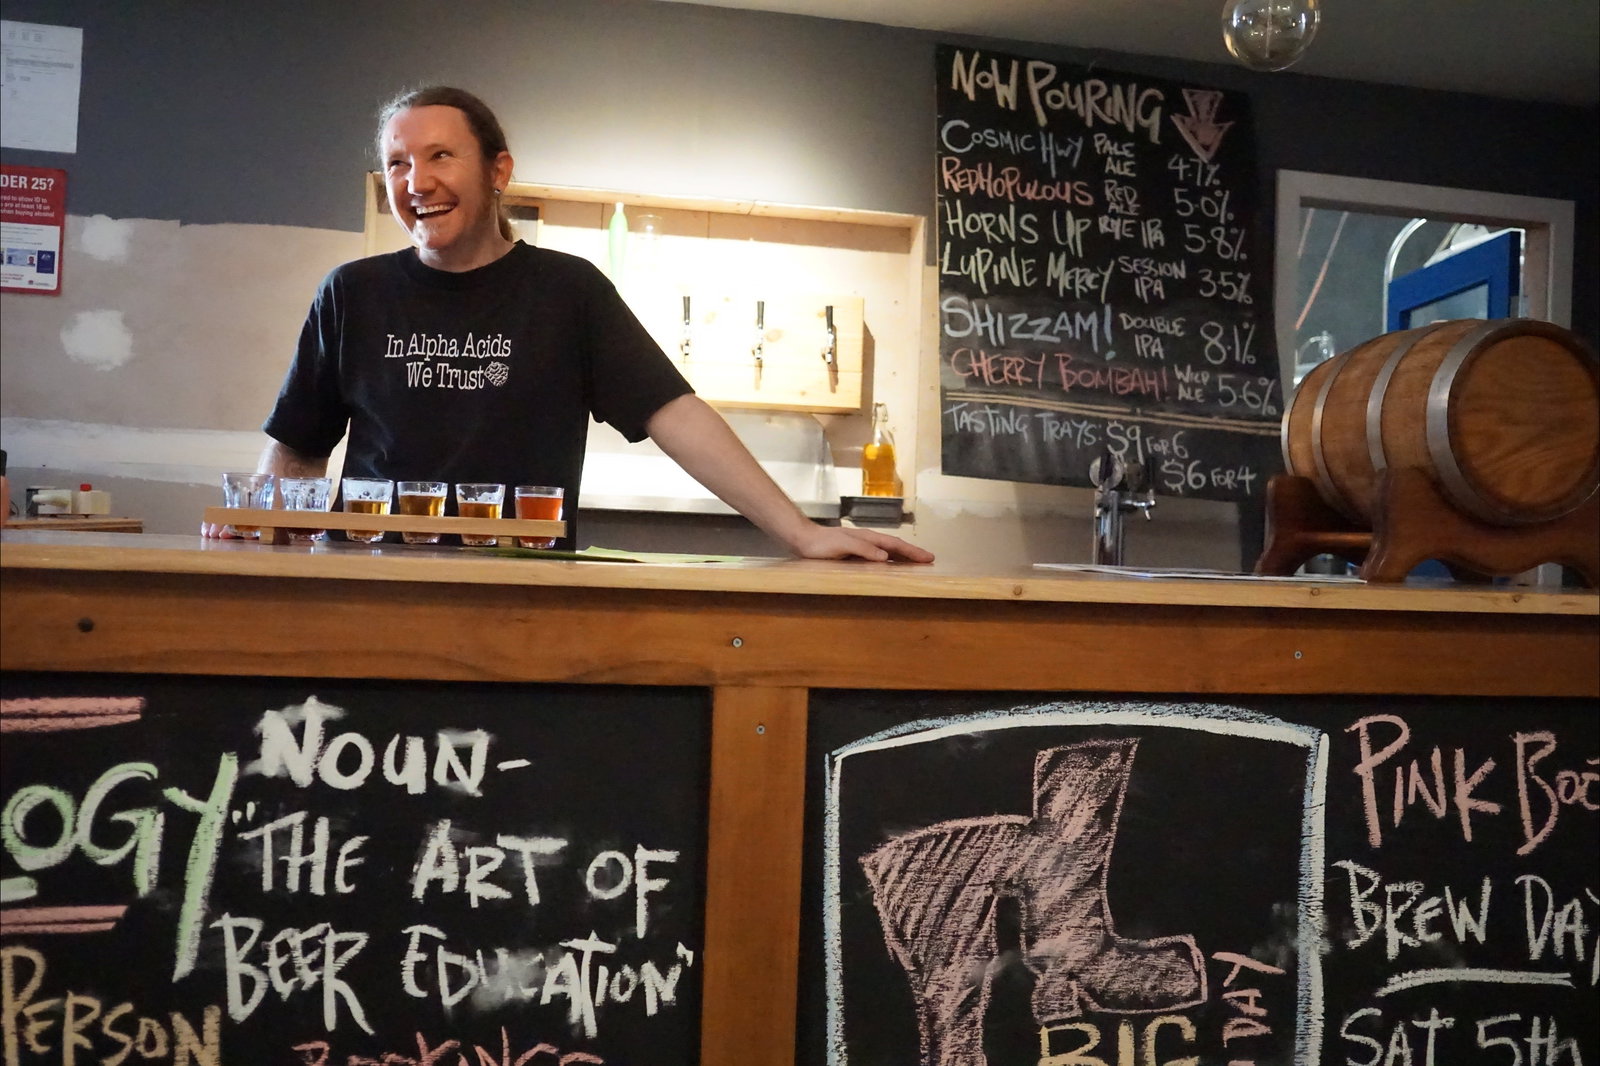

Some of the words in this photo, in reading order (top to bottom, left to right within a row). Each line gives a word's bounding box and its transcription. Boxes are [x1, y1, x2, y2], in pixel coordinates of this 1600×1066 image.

[951, 50, 1018, 110] NOW
[1027, 61, 1163, 144] POURING
[941, 120, 1036, 153] COSMIC
[1093, 133, 1135, 157] PALE
[1, 174, 28, 189] DER
[31, 177, 55, 191] 25?
[1104, 180, 1138, 205] RED
[1105, 157, 1136, 177] ALE
[946, 200, 1039, 244] HORNS
[1053, 210, 1091, 258] UP
[1141, 219, 1165, 249] IPA
[1108, 203, 1141, 216] ALE
[942, 242, 1038, 294] LUPINE
[1047, 252, 1115, 304] MERCY
[1118, 256, 1187, 280] SESSION
[1134, 277, 1165, 304] IPA
[385, 334, 404, 358] In
[406, 333, 459, 361] Alpha
[461, 332, 512, 359] Acids
[941, 296, 1116, 361] SHIZZAM!
[1119, 313, 1185, 337] DOUBLE
[1134, 334, 1165, 359] IPA
[406, 362, 432, 388] We
[436, 363, 485, 390] Trust
[950, 348, 1045, 389] CHERRY
[1178, 387, 1206, 403] ALE
[944, 401, 1029, 443] TASTING
[1106, 420, 1145, 466] $9
[1172, 431, 1189, 459] 6
[1160, 459, 1207, 495] $6
[1211, 468, 1237, 489] FOR
[1237, 466, 1257, 495] 4
[1344, 713, 1501, 848] PINK
[1509, 730, 1600, 856] BOO
[0, 751, 239, 983] OGY
[410, 819, 568, 908] ART
[586, 844, 681, 939] OF
[1331, 859, 1493, 962] BREW
[210, 912, 375, 1036] BEER
[1, 946, 222, 1066] PERSON
[1340, 1007, 1455, 1066] SAT
